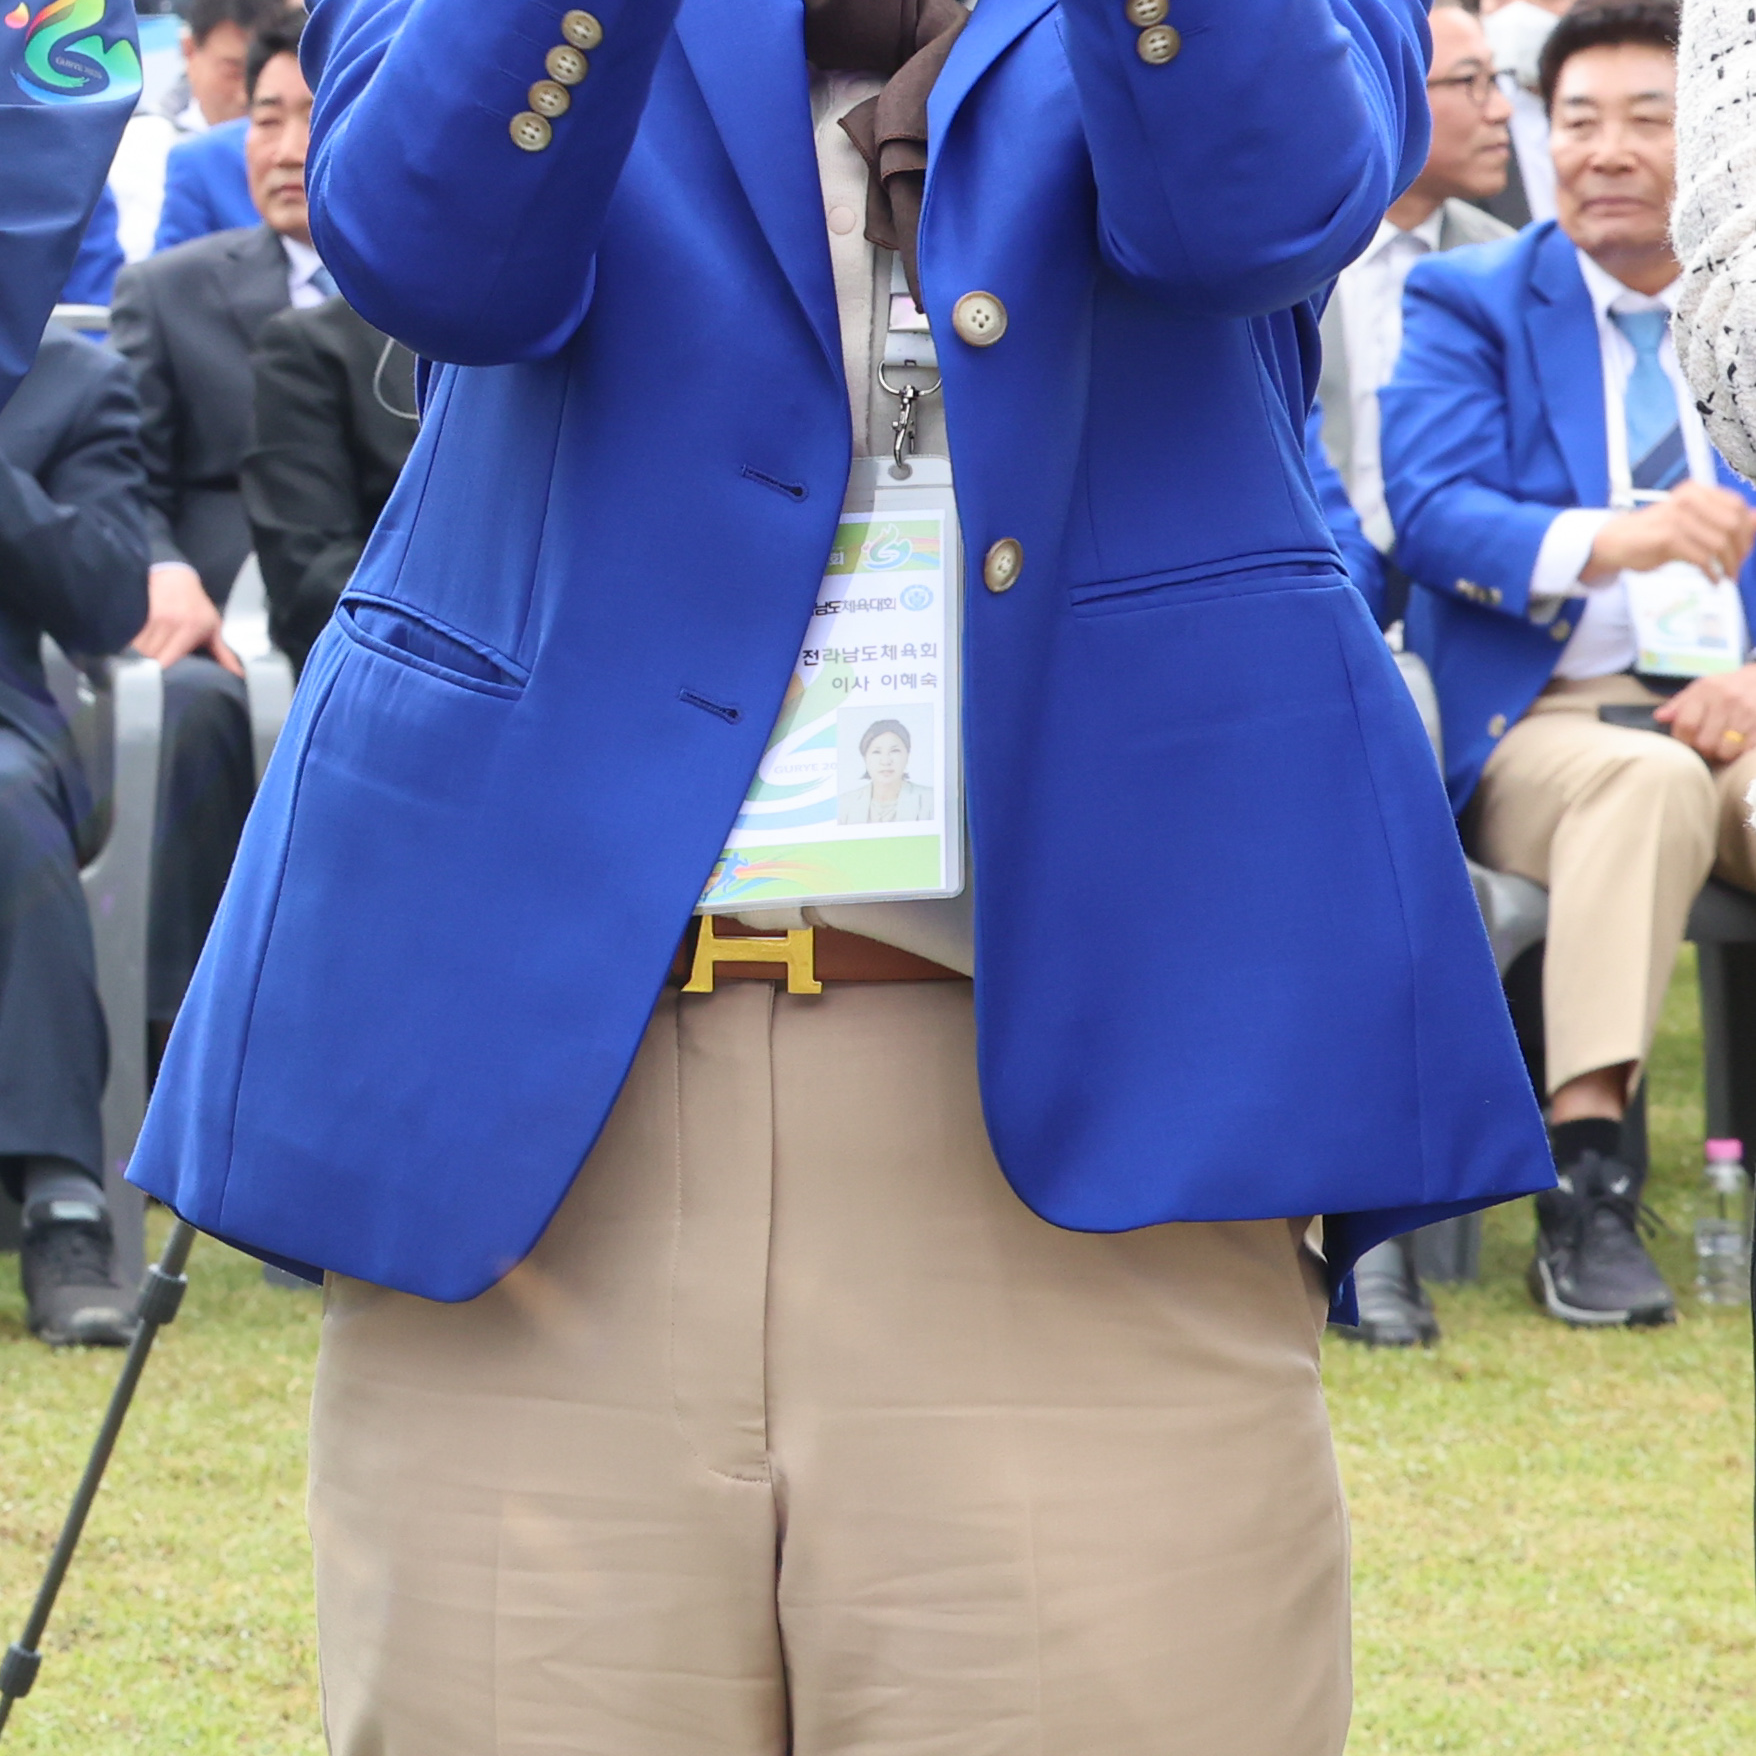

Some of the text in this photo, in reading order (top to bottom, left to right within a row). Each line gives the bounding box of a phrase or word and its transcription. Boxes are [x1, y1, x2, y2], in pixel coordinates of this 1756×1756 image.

[802, 642, 938, 666] 전라남도체육회
[832, 672, 938, 692] 이사 이혜숙
[773, 761, 838, 775] GURYE 20
